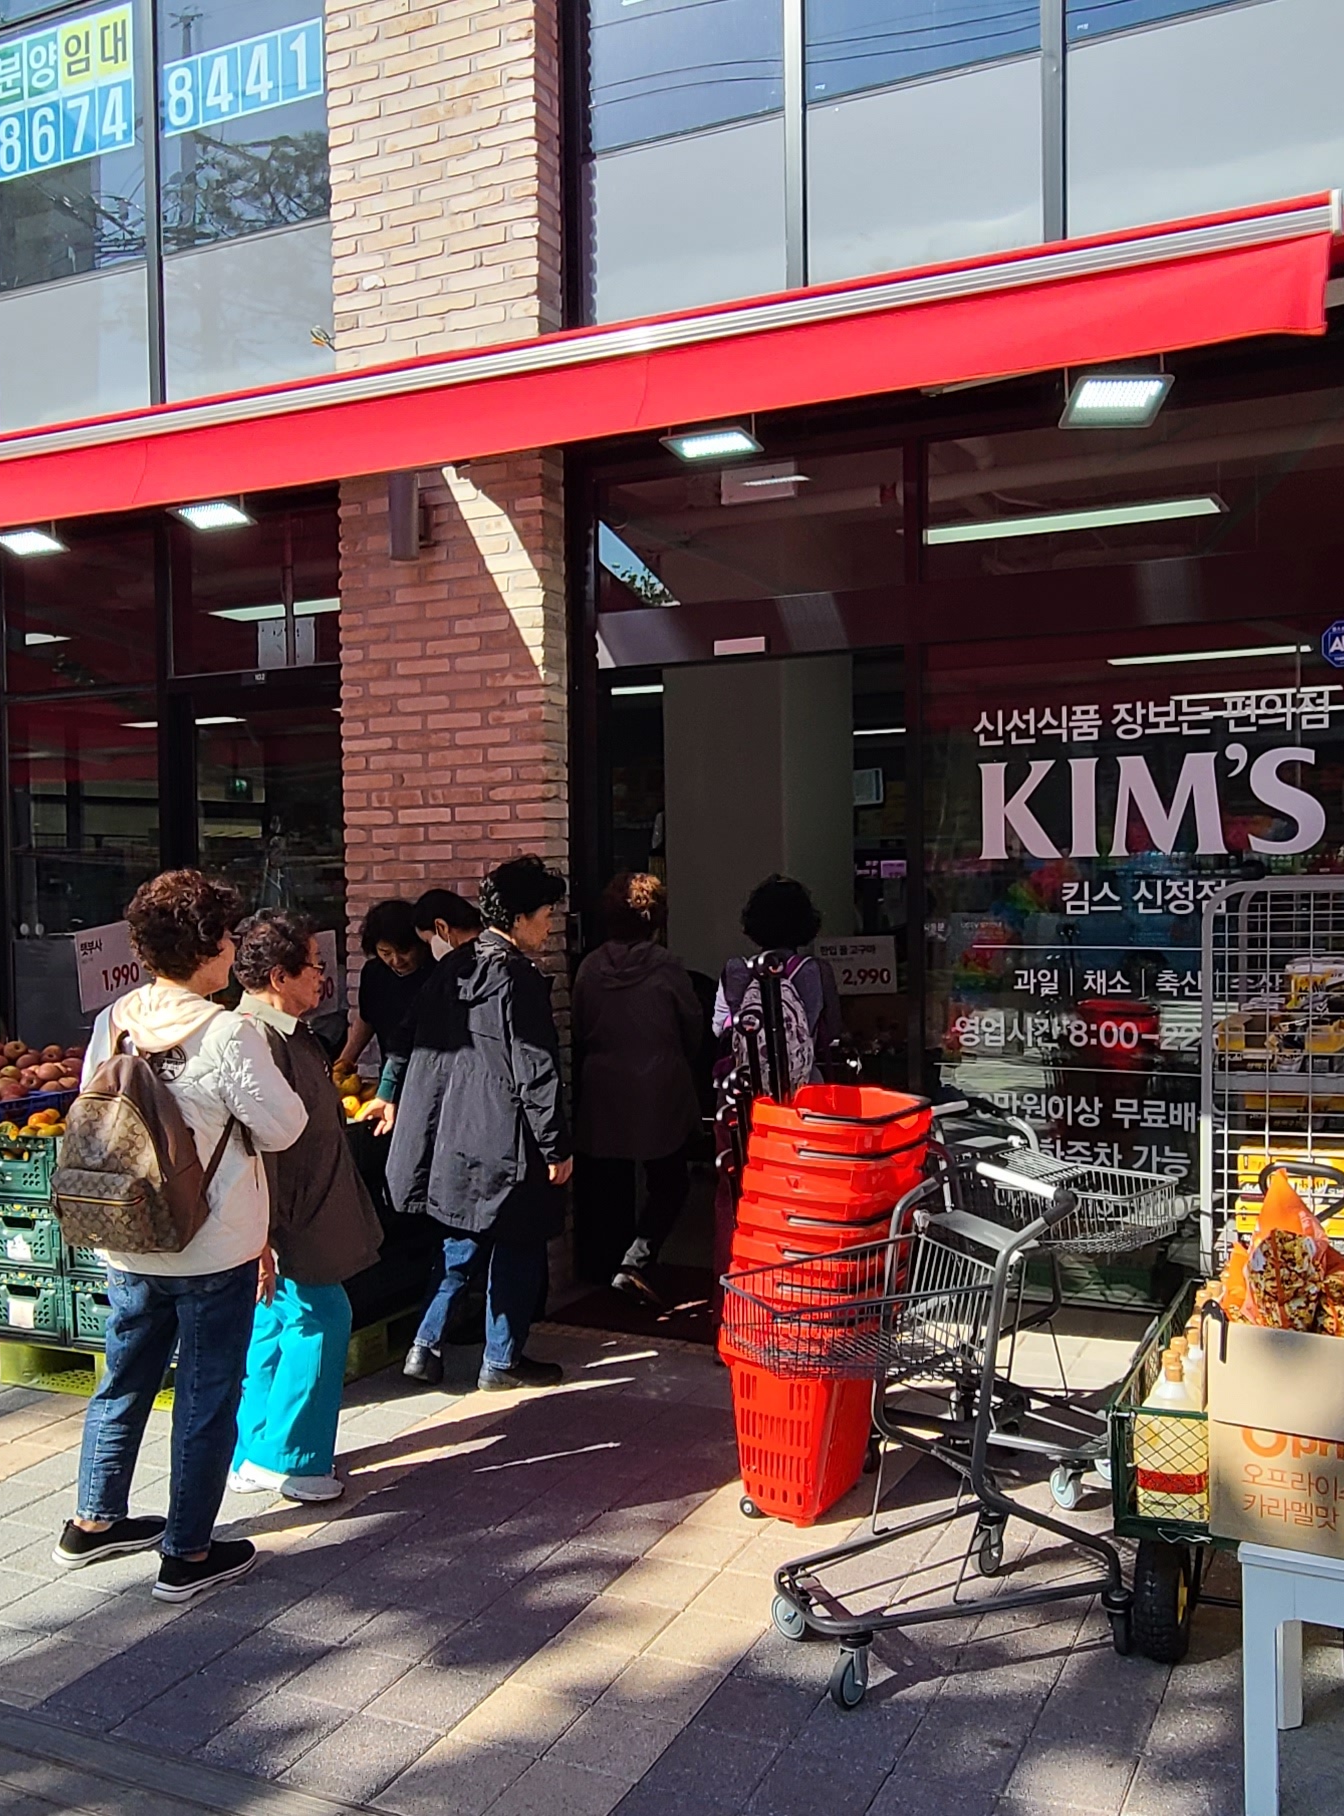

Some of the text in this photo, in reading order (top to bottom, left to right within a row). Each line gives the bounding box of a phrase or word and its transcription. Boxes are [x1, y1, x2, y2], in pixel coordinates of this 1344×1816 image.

[64, 27, 128, 72] 임대
[0, 95, 128, 174] 8674
[167, 32, 310, 128] 8441
[974, 689, 1331, 746] 신선식품 장보는 편의점
[978, 743, 1326, 860] KIM'S
[1061, 878, 1228, 915] 킴스 신정점
[102, 962, 140, 992] 1,990
[842, 968, 891, 985] 2,990
[1013, 969, 1059, 994] 과일
[1083, 970, 1132, 995] 채소
[1132, 1145, 1192, 1179] 가능
[1242, 1493, 1340, 1532] 카라멜맛
